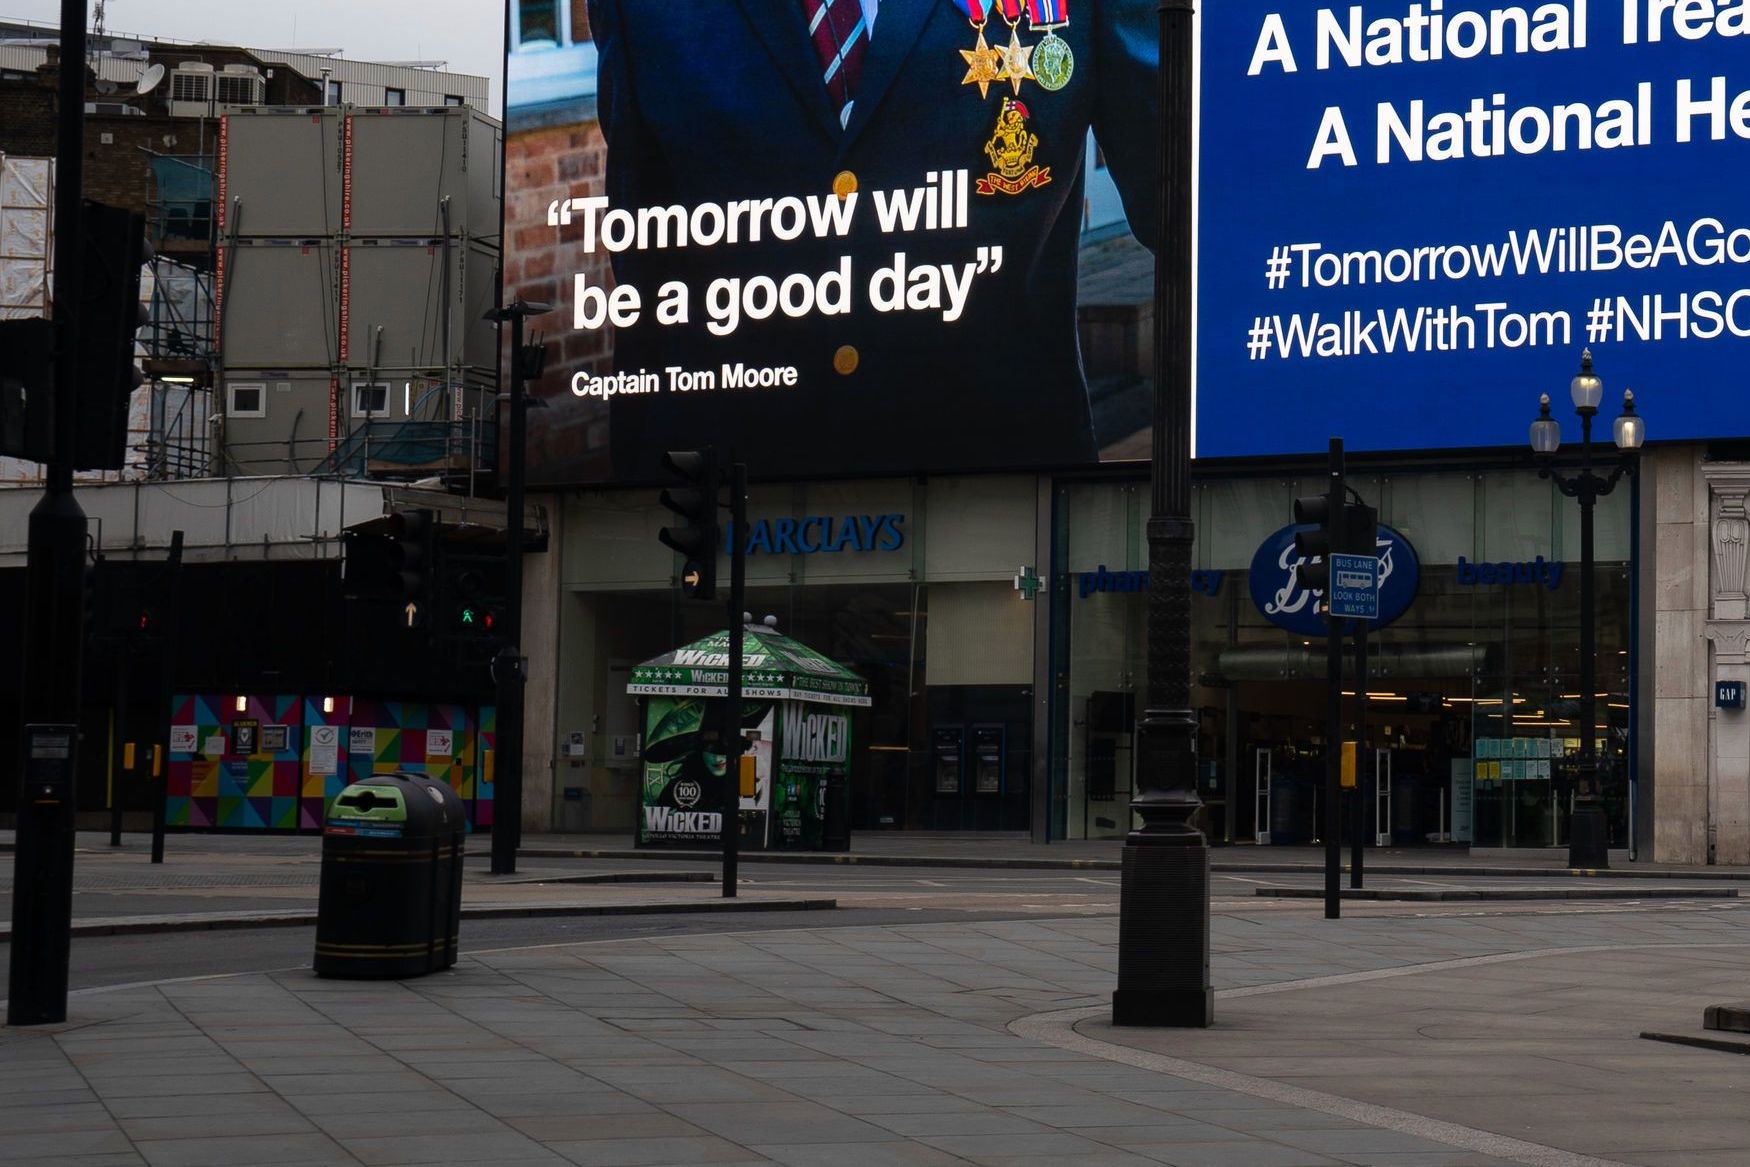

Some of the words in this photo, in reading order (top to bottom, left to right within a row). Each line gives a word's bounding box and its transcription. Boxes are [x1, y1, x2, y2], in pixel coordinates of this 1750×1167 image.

[1248, 14, 1297, 75] A
[1307, 107, 1357, 168] A
[1377, 82, 1651, 163] National
[343, 117, 353, 227] www.pickeringshire.co.uk
[548, 195, 858, 253] “Tomorrow
[873, 169, 968, 232] will
[340, 247, 349, 359] www.pickeringshire.co.uk
[574, 273, 641, 329] be
[657, 281, 688, 324] a
[706, 254, 851, 335] good
[869, 246, 1002, 321] day”
[1247, 303, 1570, 359] #WalkWithTom
[572, 369, 659, 400] Captain
[666, 367, 714, 391] Tom
[722, 363, 797, 388] Moore
[1336, 558, 1352, 569] BUS
[1353, 560, 1373, 570] LANE
[1458, 555, 1564, 591] beauty
[1333, 591, 1354, 602] LOOK
[1355, 592, 1376, 602] BOTH
[1343, 605, 1365, 614] WAYS
[1719, 688, 1736, 701] GAP
[678, 786, 697, 797] 100
